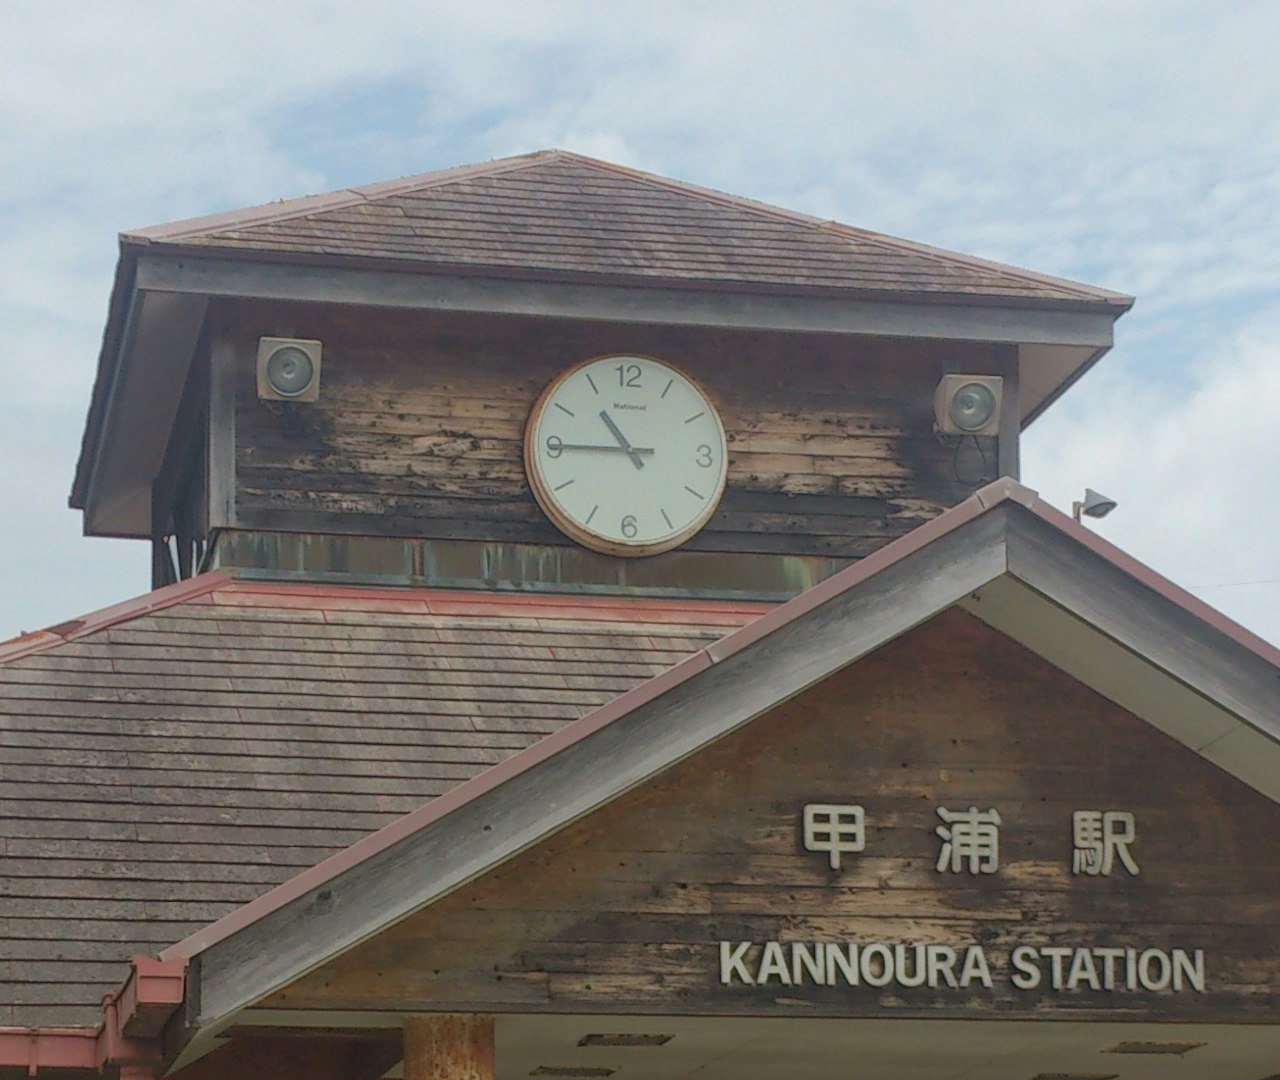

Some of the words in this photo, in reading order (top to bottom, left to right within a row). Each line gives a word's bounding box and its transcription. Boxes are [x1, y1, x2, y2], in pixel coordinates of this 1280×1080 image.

[615, 364, 642, 388] 12
[613, 402, 647, 412] National
[546, 435, 562, 459] 9
[695, 444, 713, 468] 3
[621, 515, 638, 538] 6
[802, 803, 1140, 877] 甲浦駅
[720, 940, 993, 988] KANNOURA
[1010, 945, 1206, 991] STATION
